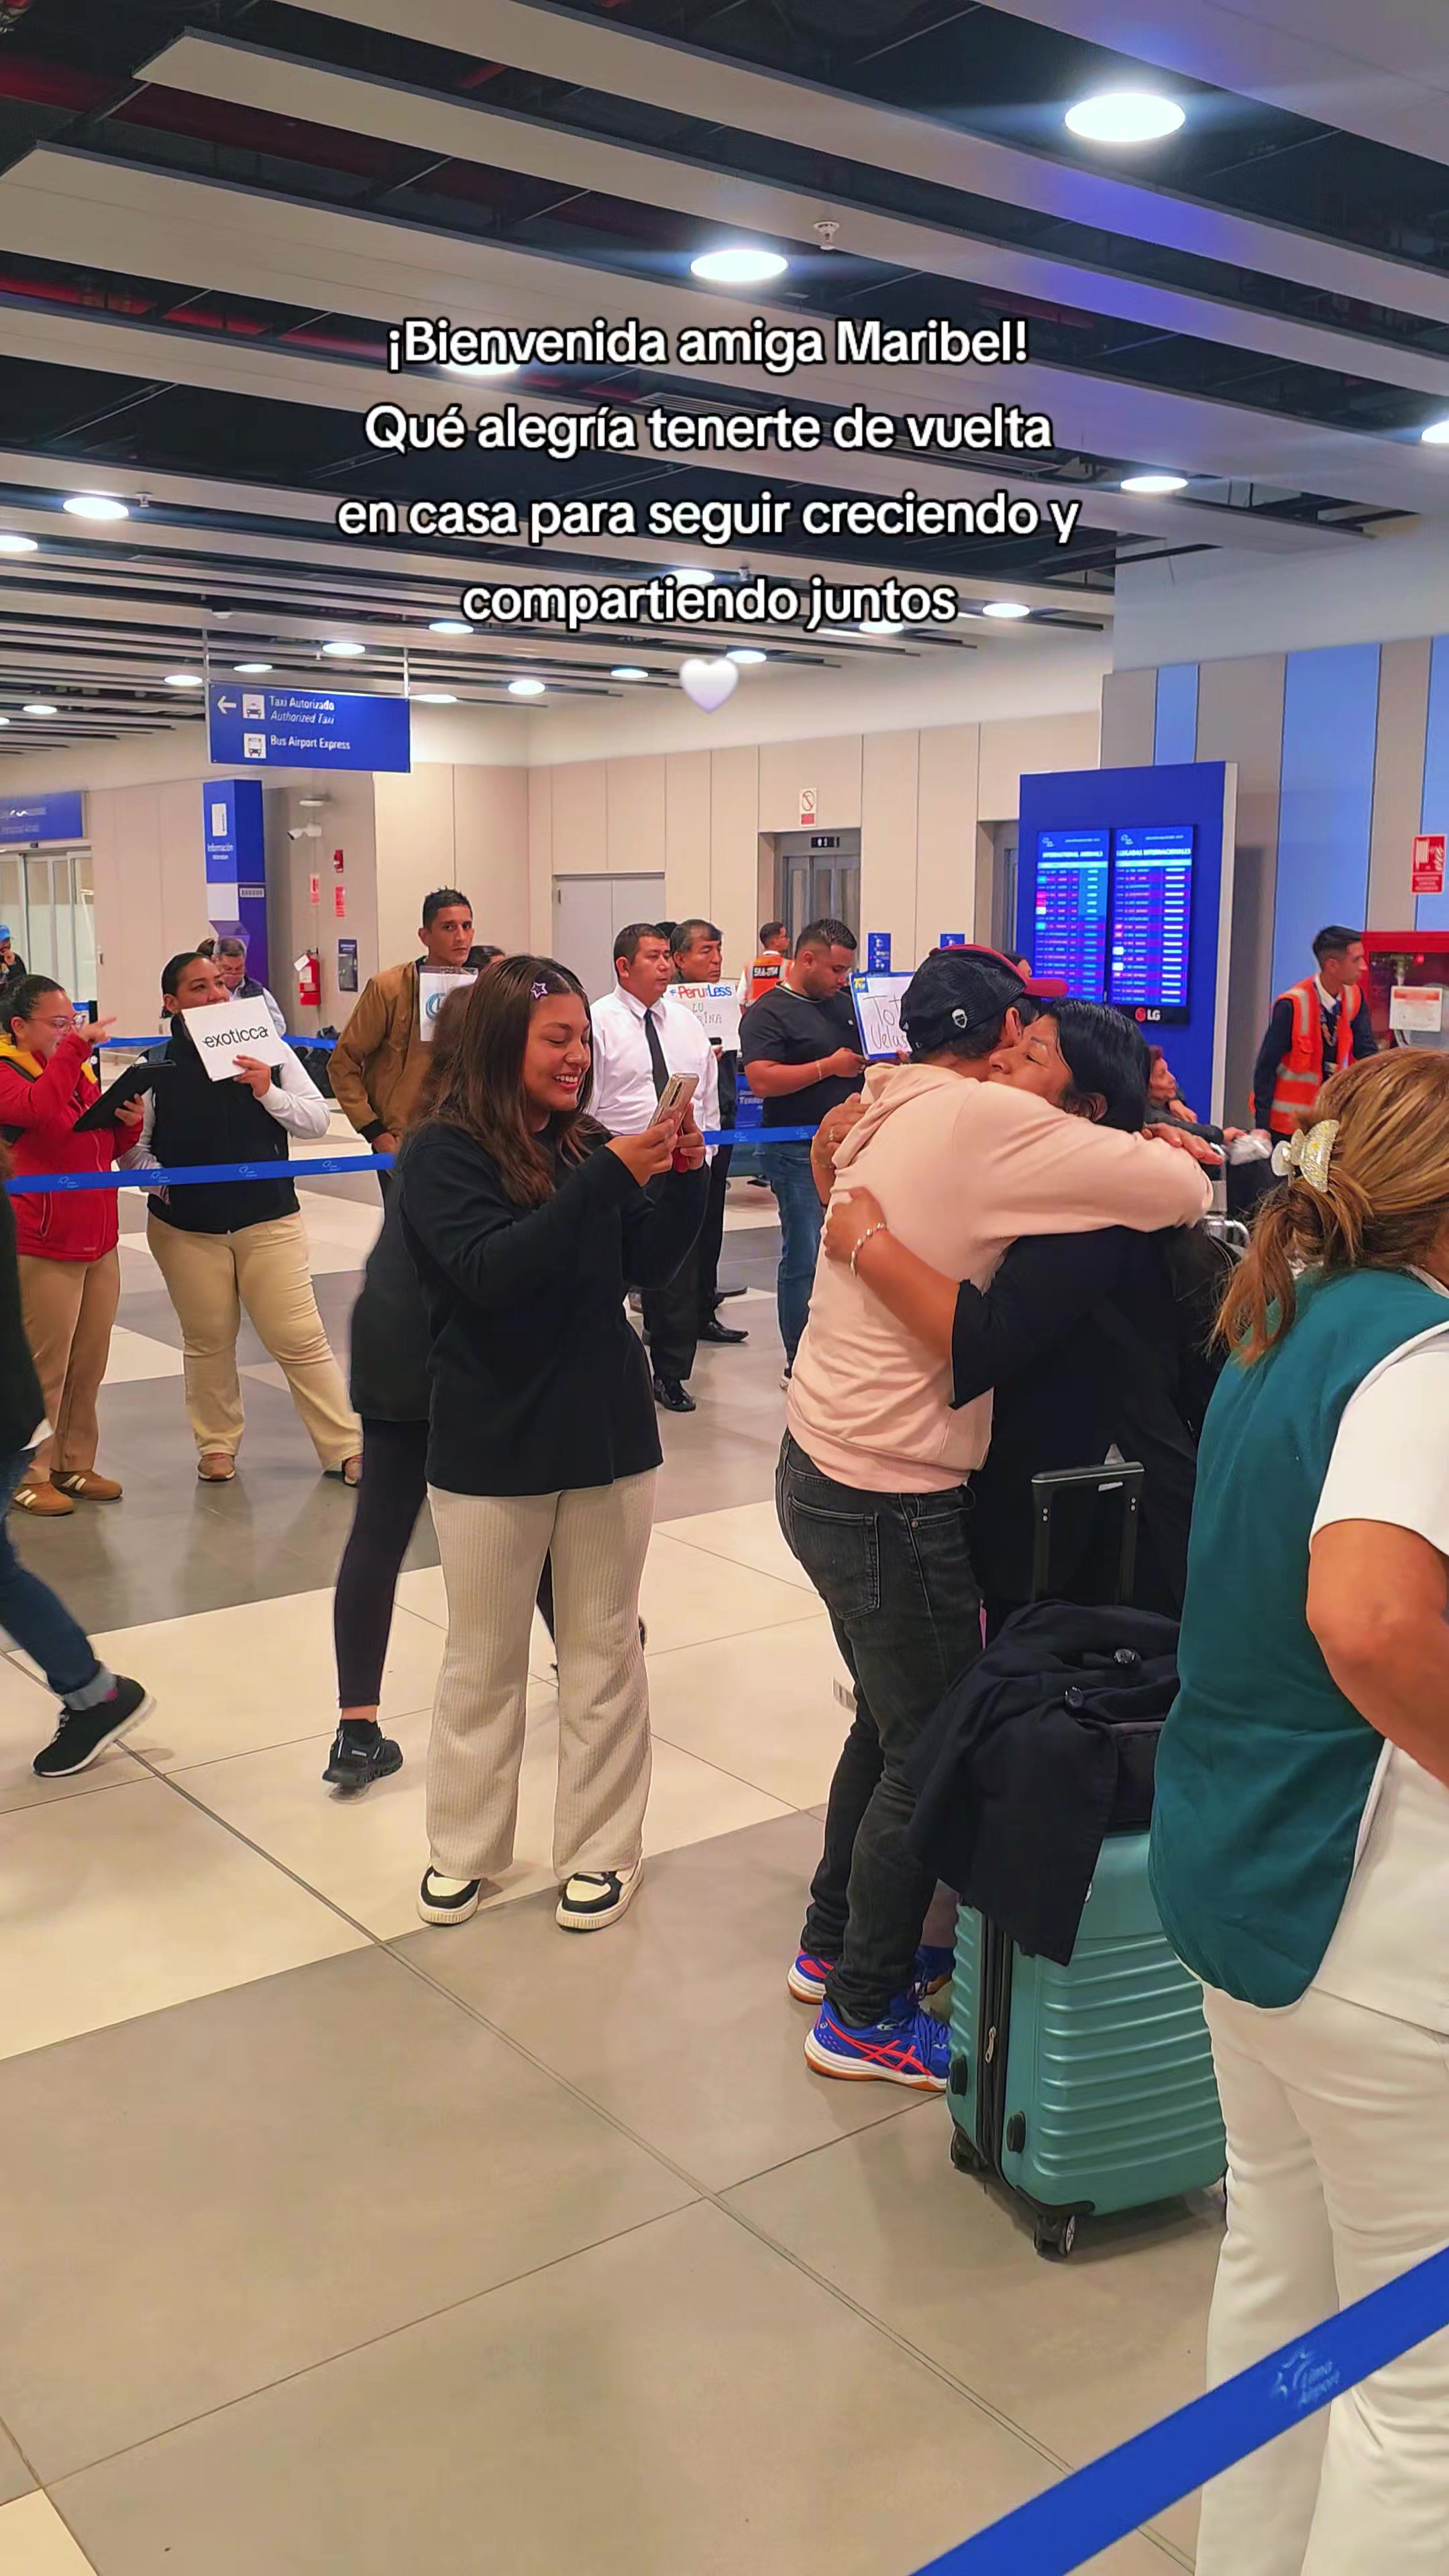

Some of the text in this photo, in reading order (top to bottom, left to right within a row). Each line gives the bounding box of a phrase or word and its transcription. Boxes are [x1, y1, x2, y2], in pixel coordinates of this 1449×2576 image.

[270, 695, 335, 711] Taxi Autorizado
[270, 710, 335, 724] Authorized Taxi
[270, 735, 351, 751] Bus Airport Express
[1147, 1008, 1161, 1020] LG
[202, 1026, 269, 1048] exoticca
